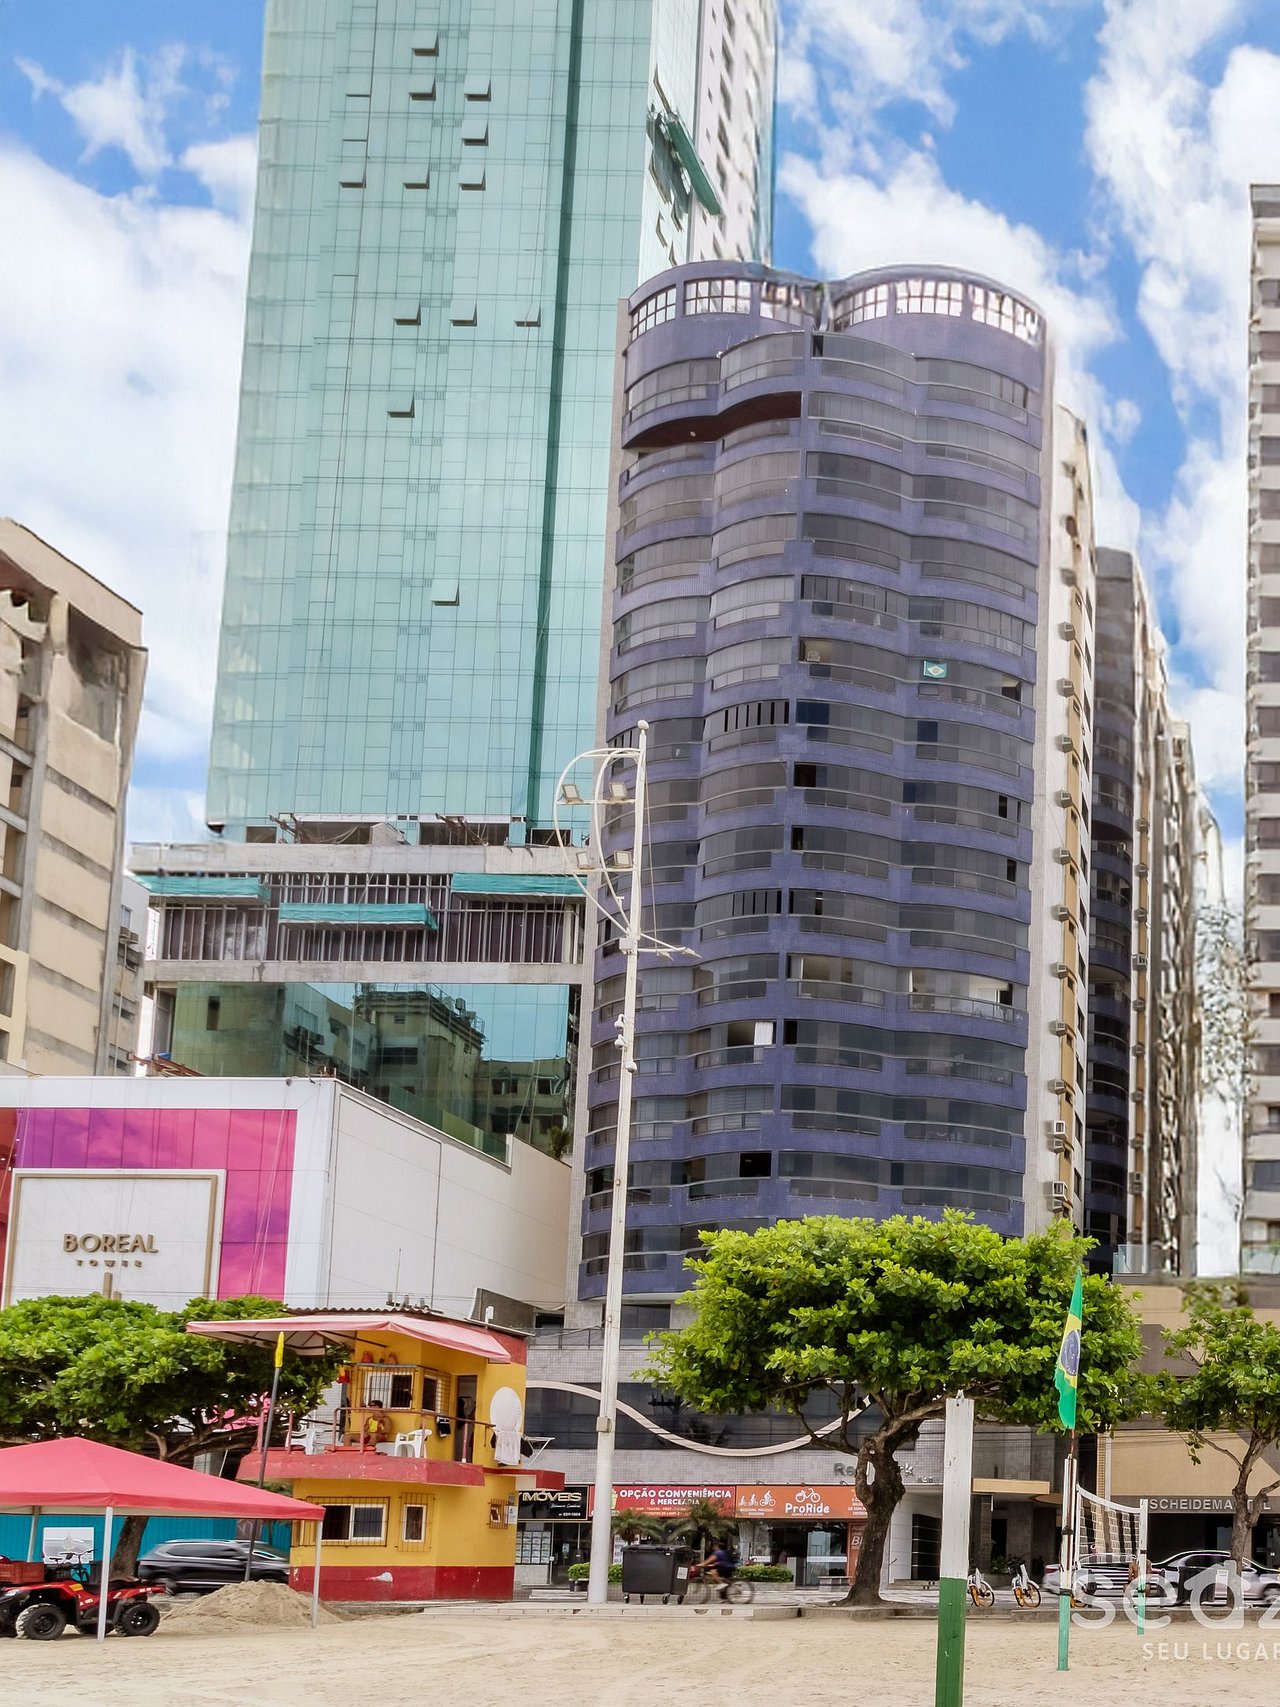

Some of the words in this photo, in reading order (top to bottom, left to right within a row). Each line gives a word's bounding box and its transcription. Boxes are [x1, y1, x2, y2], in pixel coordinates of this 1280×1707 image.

[63, 1234, 159, 1253] BOREAL
[76, 1259, 143, 1268] TOWER
[522, 1490, 582, 1502] IMÓVEIS
[619, 1488, 656, 1500] OPÇÃO
[657, 1488, 732, 1499] CONVENIÊNCIA
[785, 1502, 830, 1514] ProRide
[1149, 1499, 1272, 1511] SCHEIDEMATL
